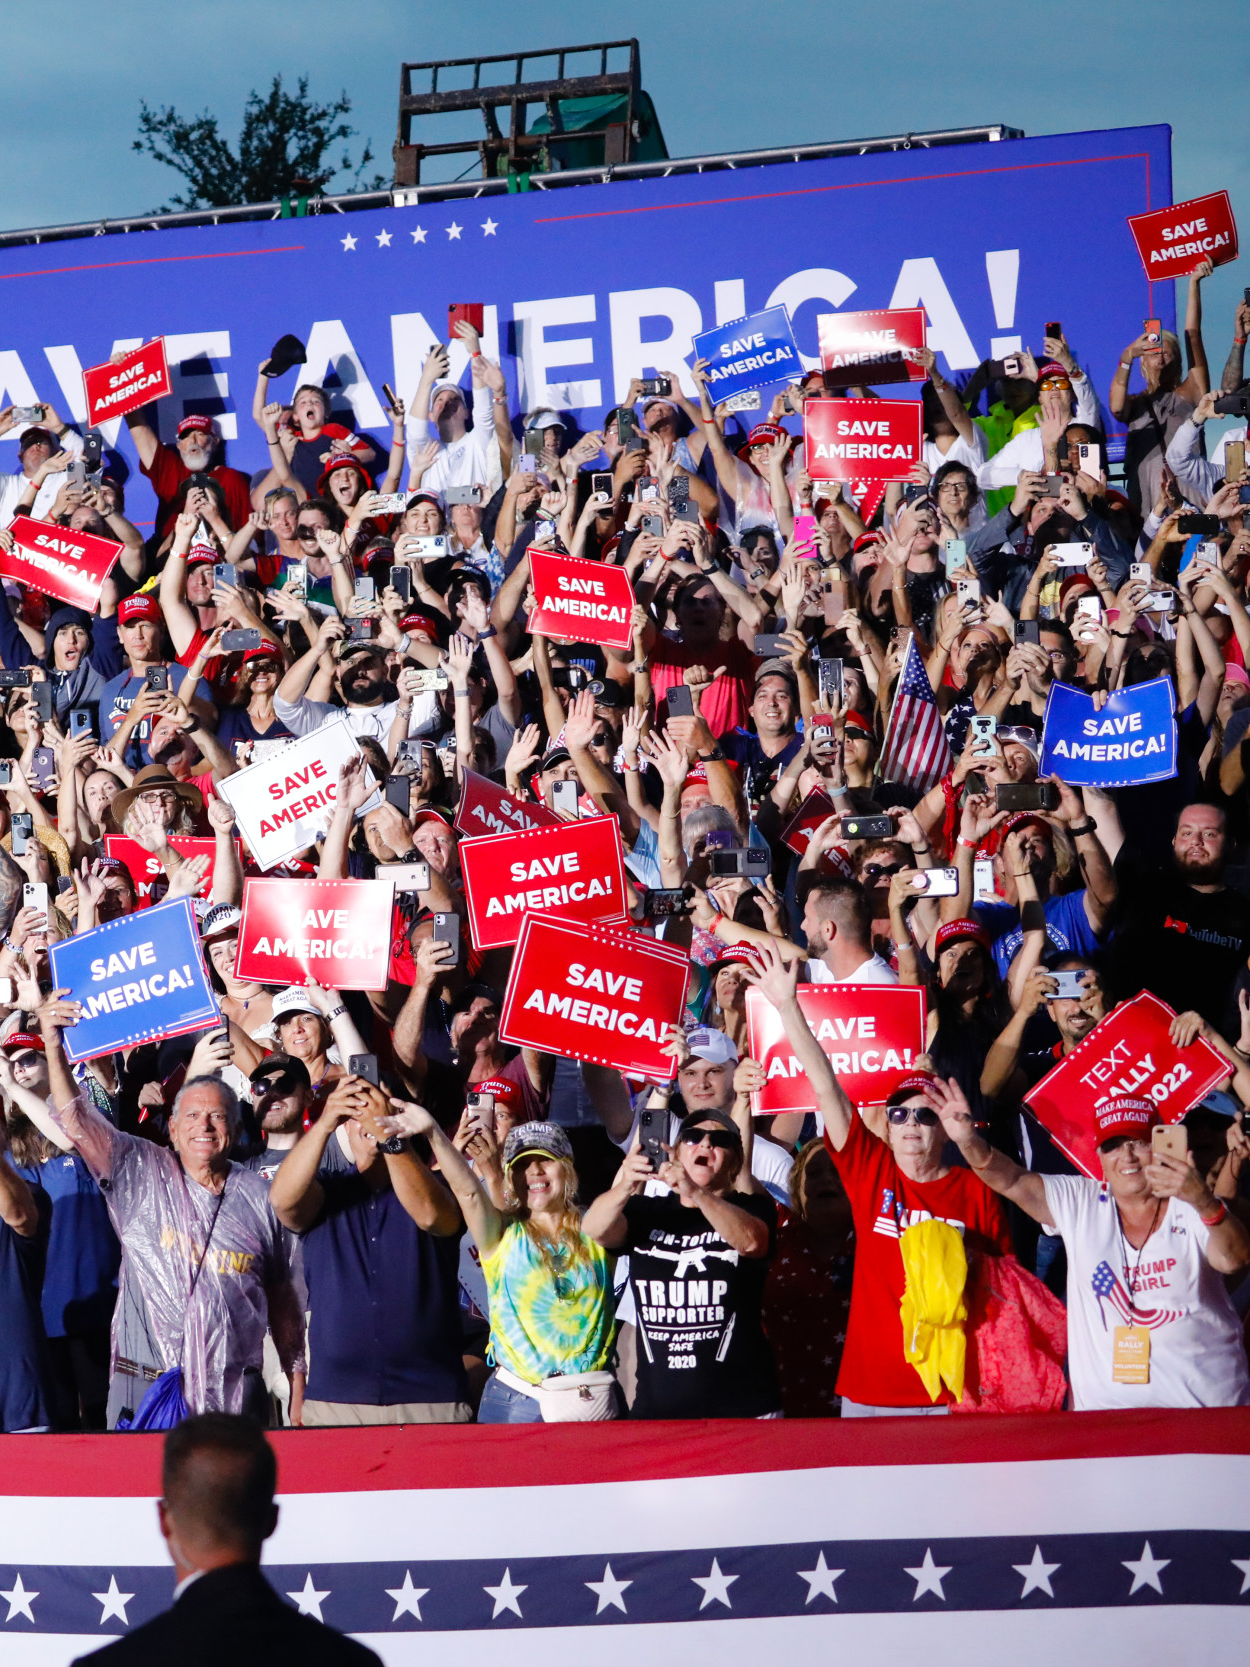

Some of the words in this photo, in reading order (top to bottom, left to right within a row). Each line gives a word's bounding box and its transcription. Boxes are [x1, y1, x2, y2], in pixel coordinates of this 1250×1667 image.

[1161, 218, 1207, 241] SAVE
[1150, 231, 1229, 263] AMERICA!
[720, 332, 765, 359] SAVE
[109, 362, 145, 389] SAVE
[709, 347, 794, 383] AMERICA!
[94, 370, 162, 411] AMERICA!
[837, 420, 889, 438] SAVE
[814, 442, 913, 461] AMERICA!
[35, 534, 85, 561] SAVE
[6, 542, 97, 586] AMERICA!
[557, 576, 606, 597] SAVE
[541, 595, 626, 624] AMERICA!
[1082, 712, 1142, 737] SAVE
[1053, 733, 1166, 762] AMERICA!
[268, 759, 327, 801] SAVE
[259, 783, 338, 838] AMERIC
[499, 799, 541, 832] SAV
[510, 852, 580, 883] SAVE
[486, 875, 613, 918] AMERICA!
[301, 909, 349, 929] AVE
[253, 936, 375, 959] AMERICA!
[90, 941, 157, 982] SAVE
[77, 965, 195, 1020] AMERICA!
[566, 963, 643, 1001] SAVE
[523, 989, 670, 1044] AMERICA!
[767, 1048, 911, 1077] AMRICA!
[1081, 1040, 1135, 1089] TEXT
[479, 1081, 512, 1093] Trump
[1095, 1102, 1115, 1118] MAKE
[1116, 1100, 1153, 1112] AMERICA
[1099, 1113, 1123, 1129] GREAT
[1123, 1112, 1149, 1123] AGAIN
[513, 1124, 552, 1139] TRUMP
[1123, 1258, 1177, 1279] TRUMP
[635, 1280, 728, 1307] TRUMP
[1132, 1275, 1170, 1292] GIRL
[642, 1304, 724, 1324] SUPPORTER
[648, 1331, 669, 1342] KEEP
[672, 1329, 719, 1342] AMERICA
[668, 1342, 693, 1352] SAFE
[1118, 1340, 1143, 1349] RALLY
[667, 1354, 696, 1369] 2020
